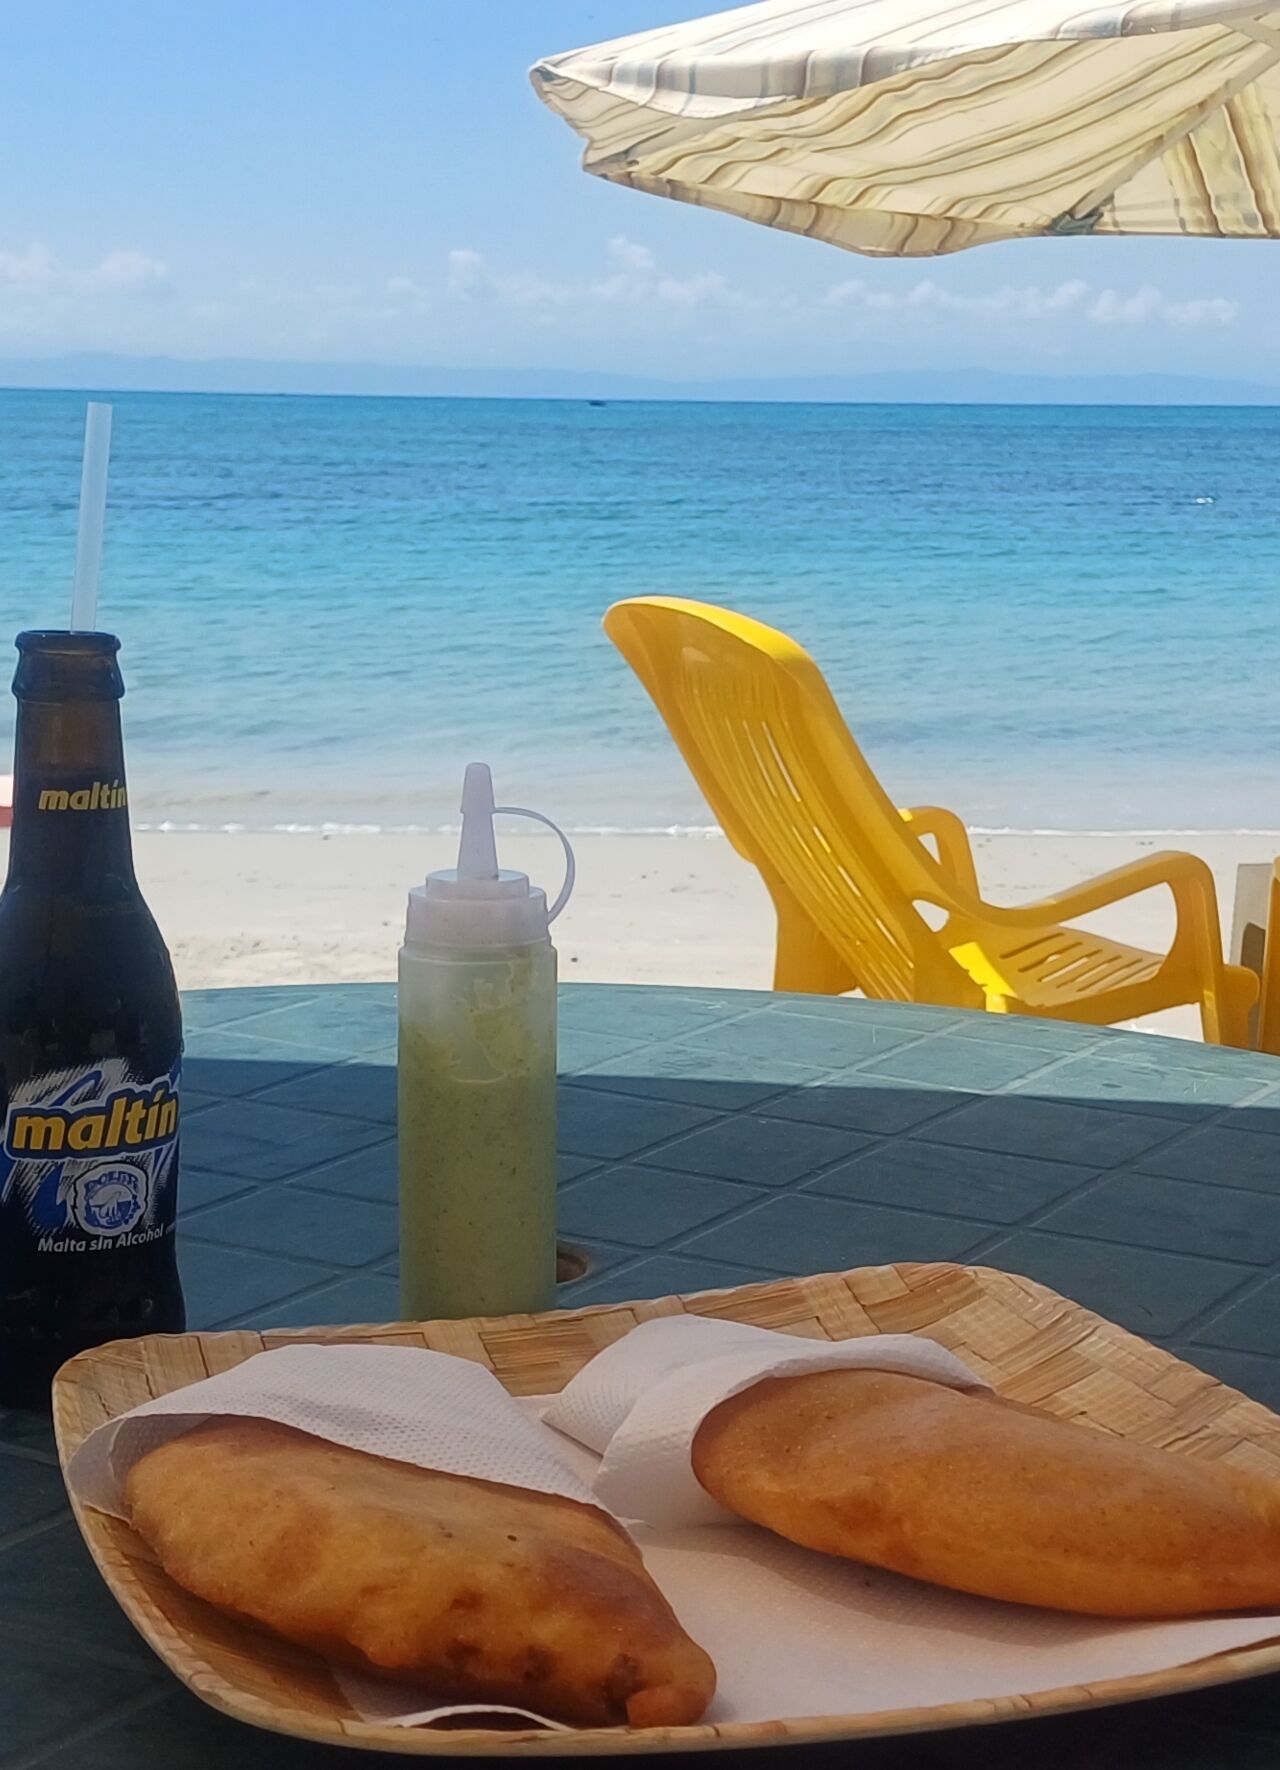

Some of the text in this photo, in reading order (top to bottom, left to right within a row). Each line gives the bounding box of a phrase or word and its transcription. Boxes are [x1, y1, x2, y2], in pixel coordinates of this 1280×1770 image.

[37, 778, 128, 811] maltín
[11, 1089, 178, 1151] maltín
[37, 1223, 164, 1253] Malta sin Alcohol
